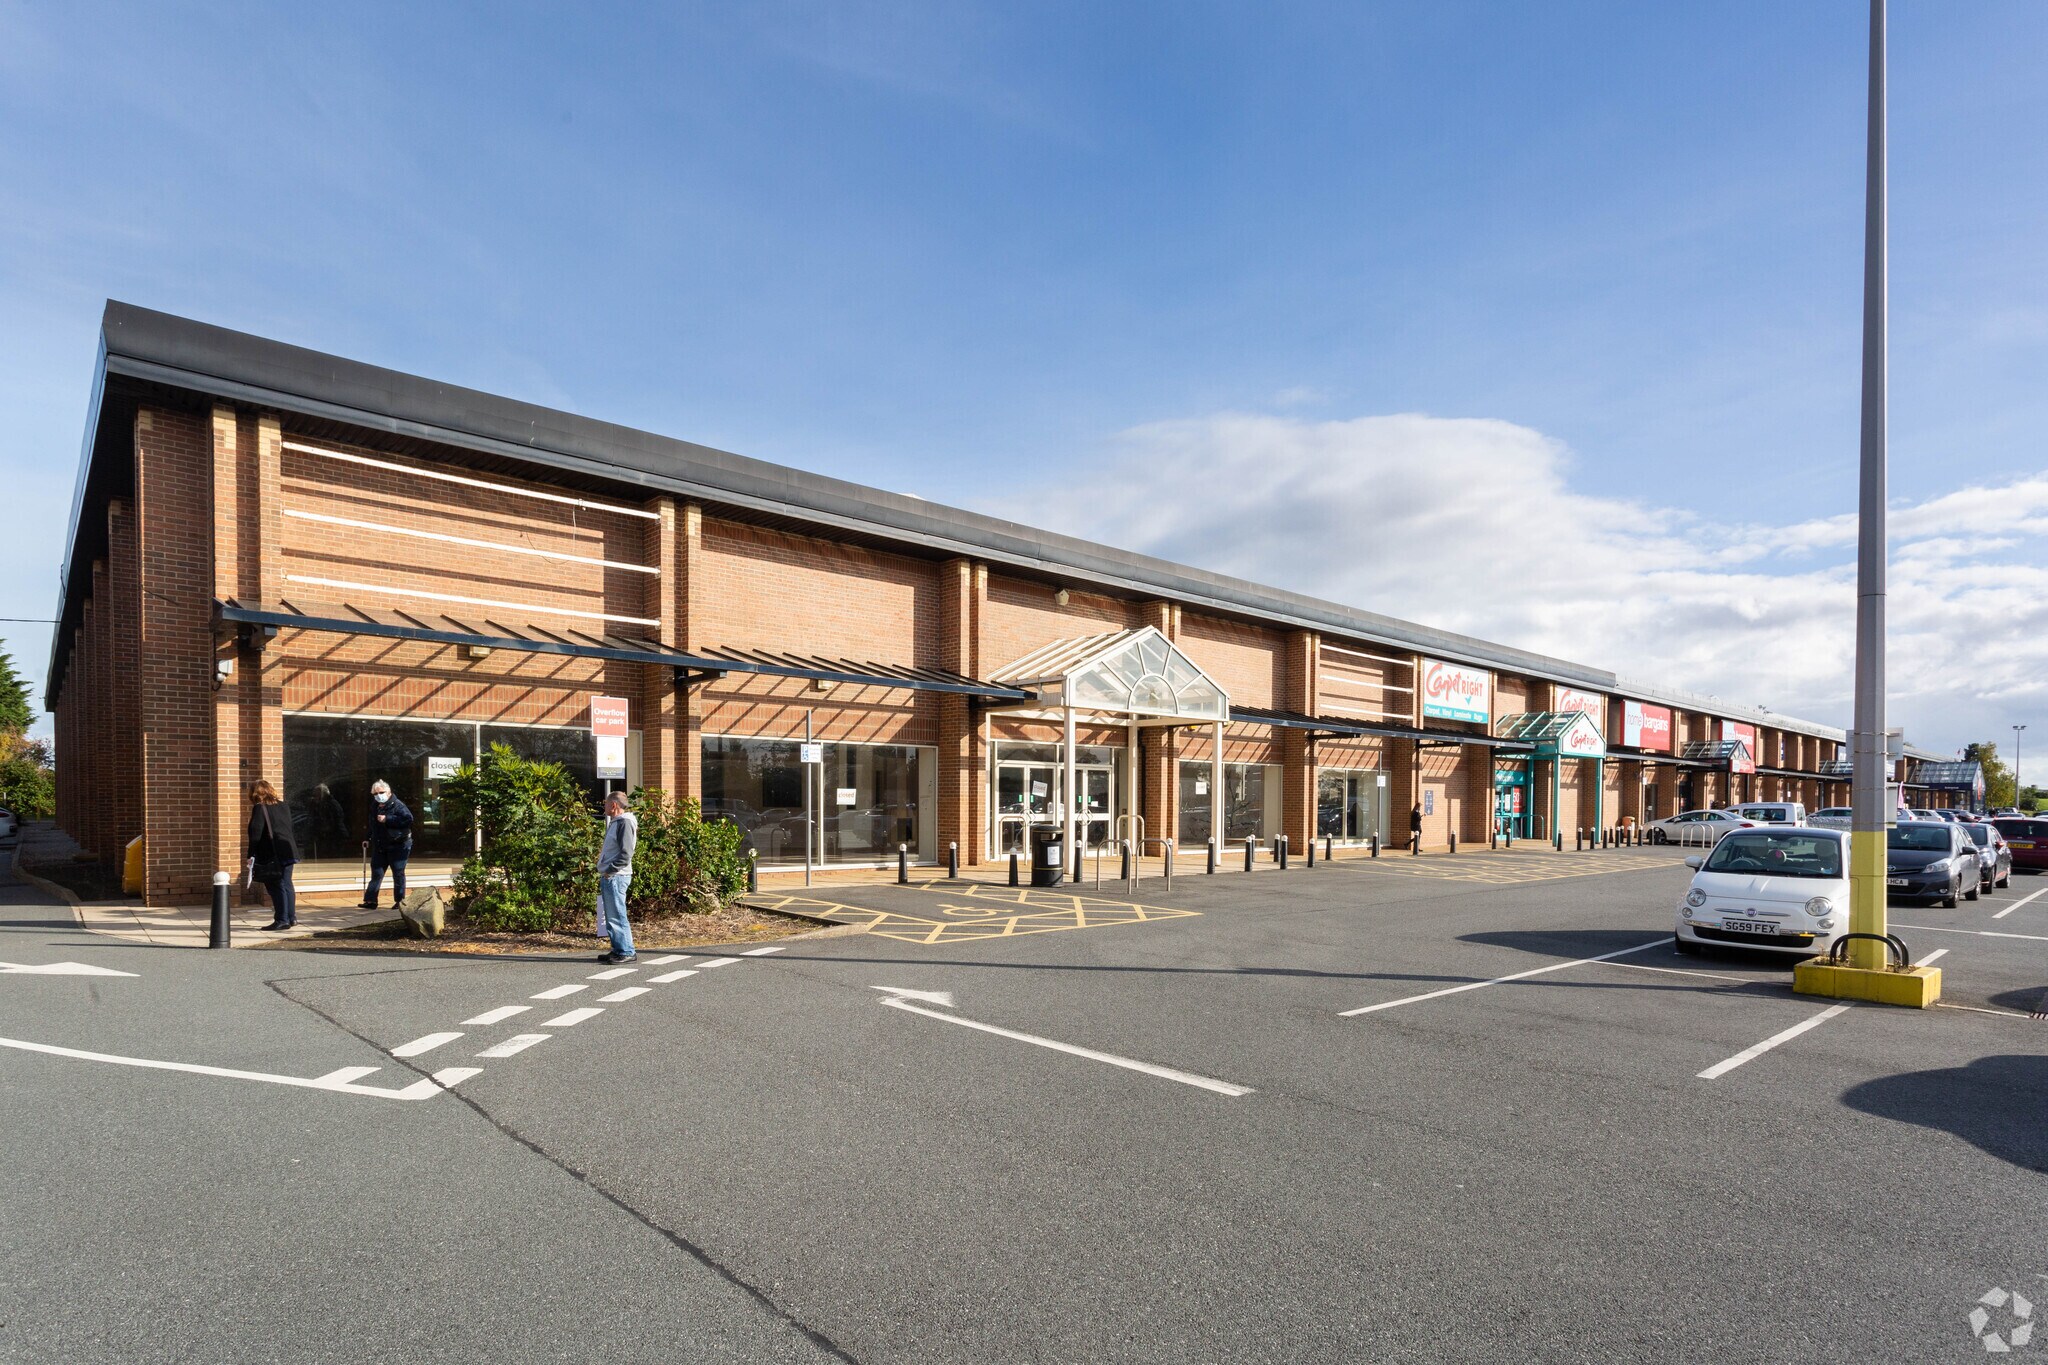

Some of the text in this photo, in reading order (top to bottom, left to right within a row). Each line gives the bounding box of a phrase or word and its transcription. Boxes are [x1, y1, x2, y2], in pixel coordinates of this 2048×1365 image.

[594, 707, 625, 717] Overflow
[608, 718, 625, 726] park
[1643, 713, 1668, 733] bargains
[1725, 921, 1775, 934] SG59 FEX
